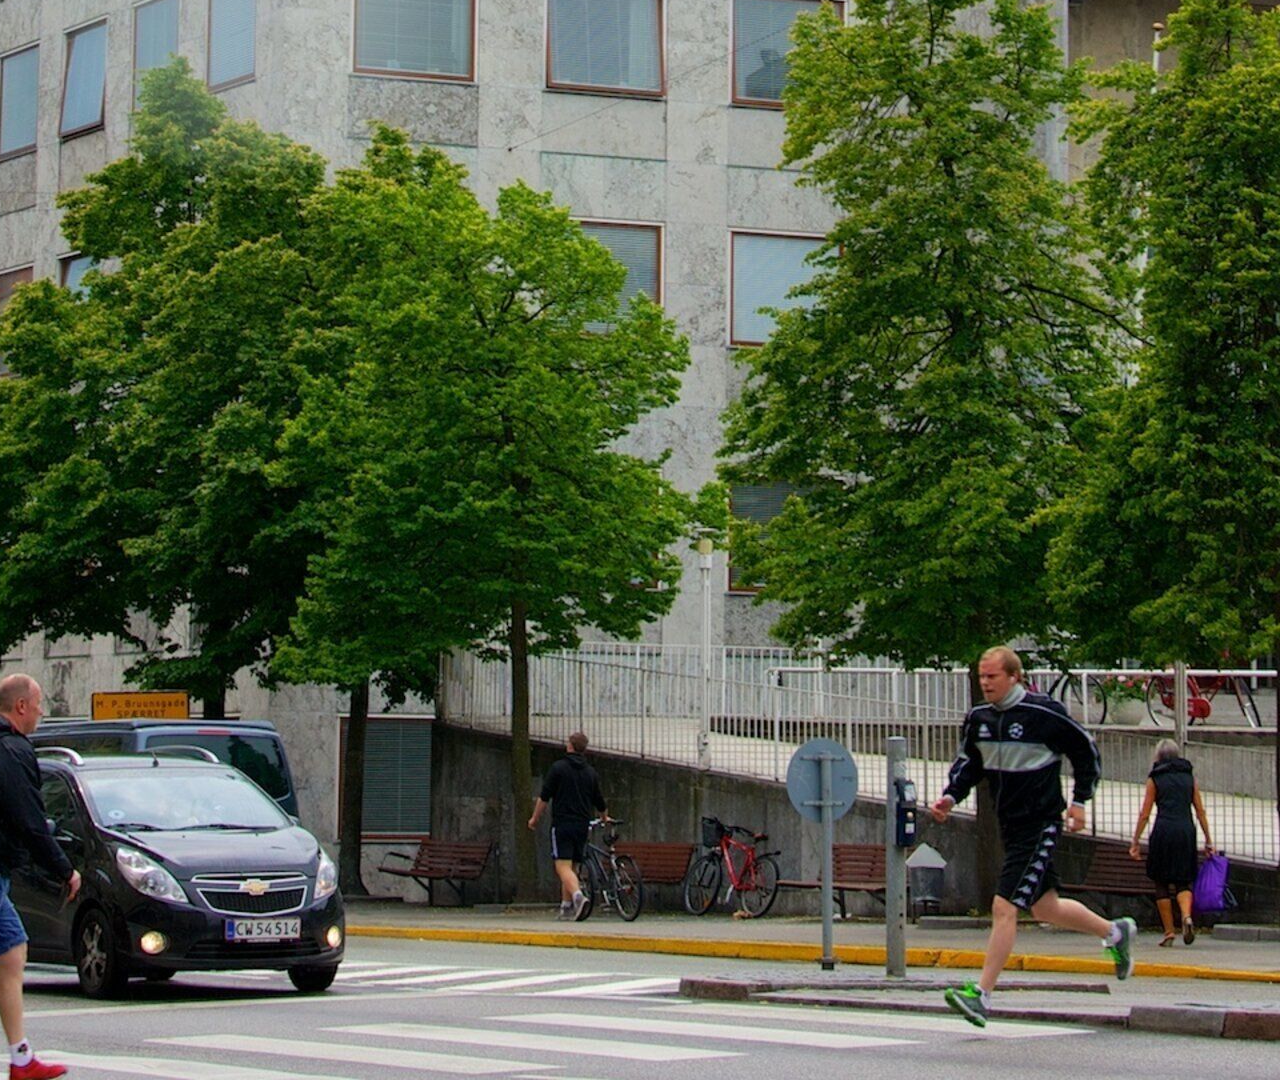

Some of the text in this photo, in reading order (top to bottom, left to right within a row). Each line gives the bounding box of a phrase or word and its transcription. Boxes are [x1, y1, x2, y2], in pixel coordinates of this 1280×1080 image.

[236, 921, 298, 936] CW 54 514
